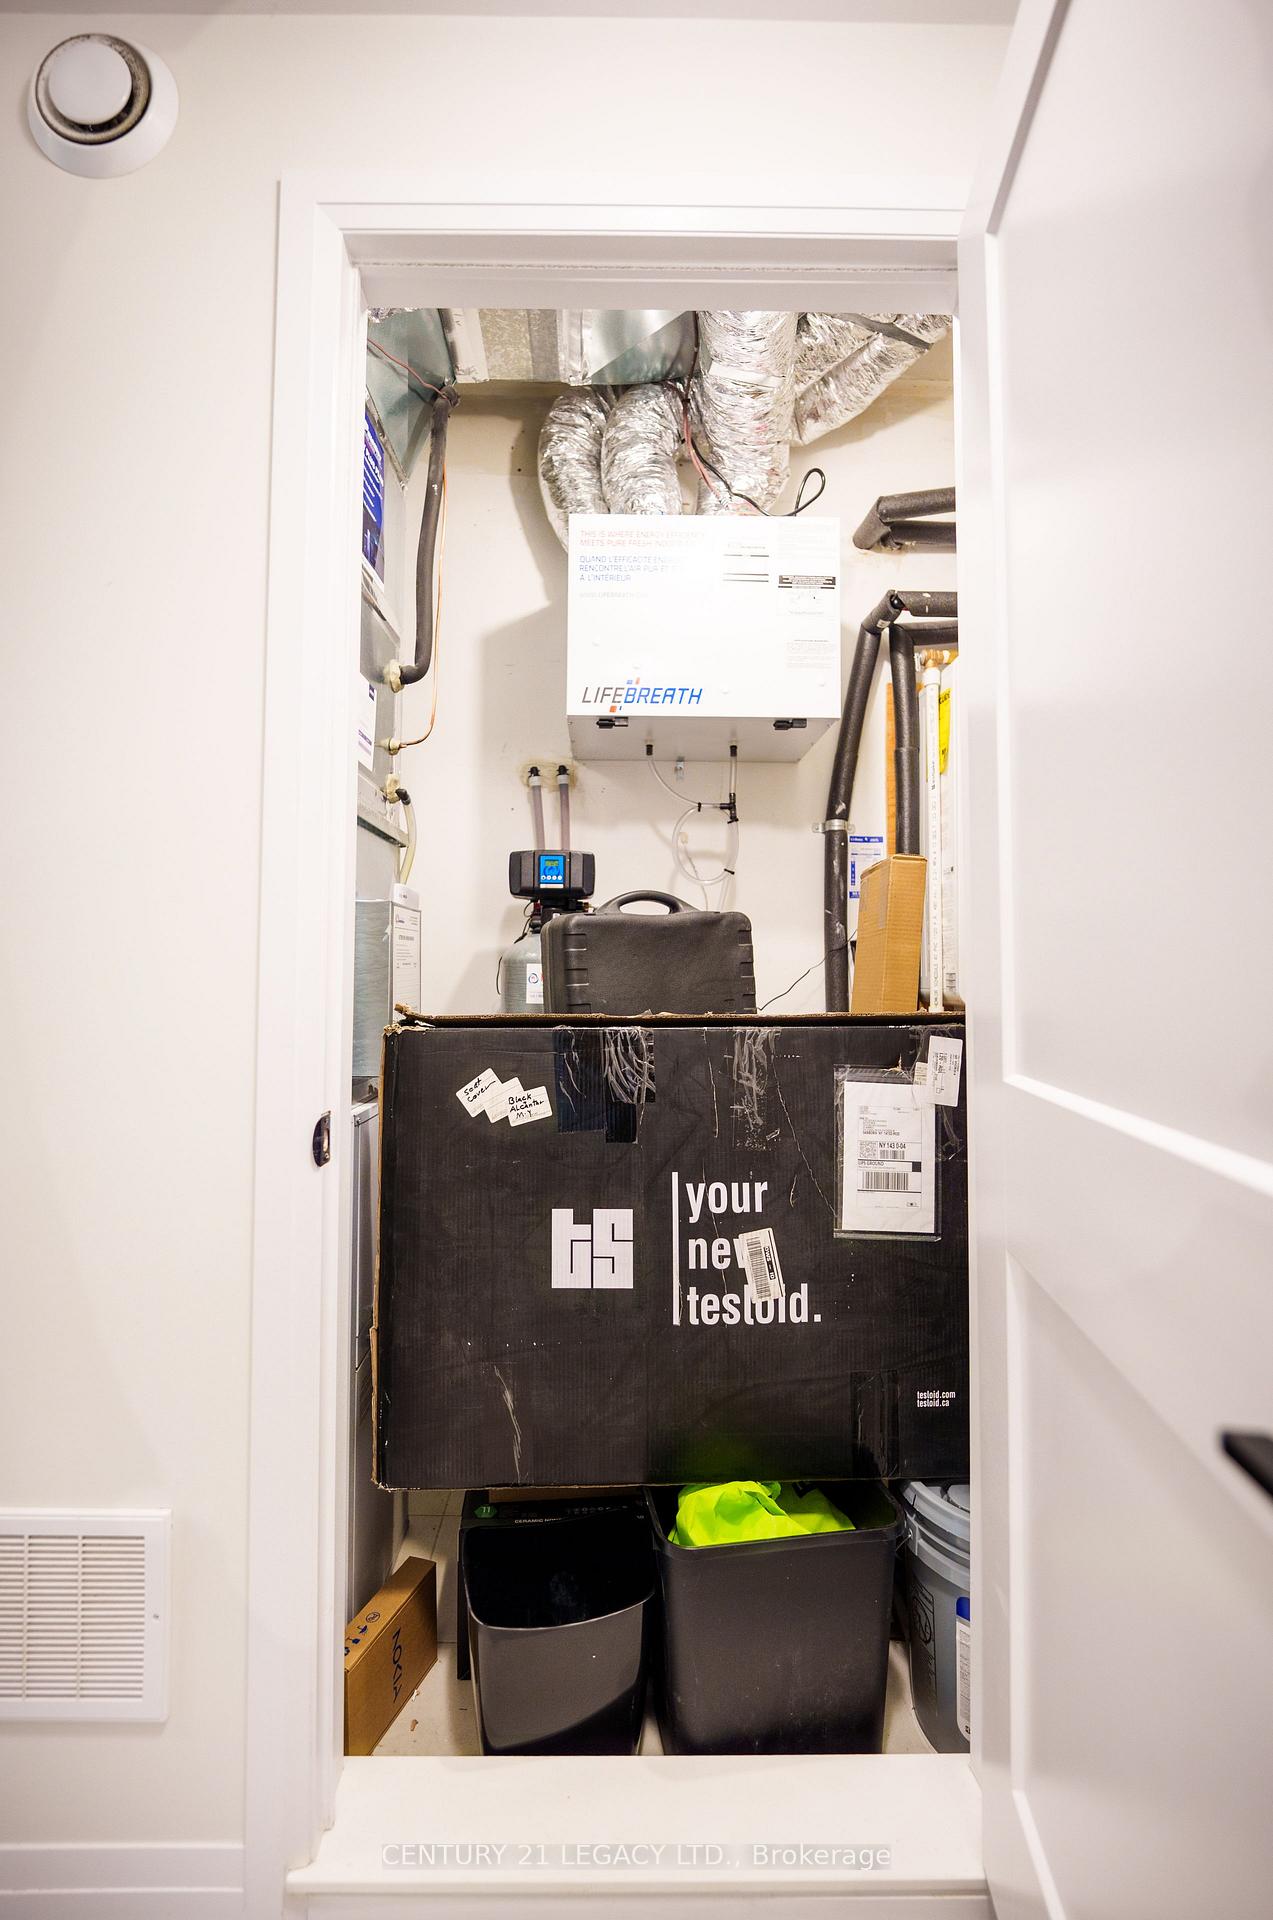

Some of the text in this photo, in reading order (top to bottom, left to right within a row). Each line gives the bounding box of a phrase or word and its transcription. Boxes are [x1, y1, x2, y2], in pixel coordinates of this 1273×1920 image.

[579, 555, 607, 563] QUAND
[579, 564, 624, 572] RENCONTRE
[582, 686, 703, 705] LIFEBREATH
[685, 1181, 768, 1224] your
[916, 1390, 956, 1400] tesloid.com
[916, 1399, 950, 1408] tesloid.ca
